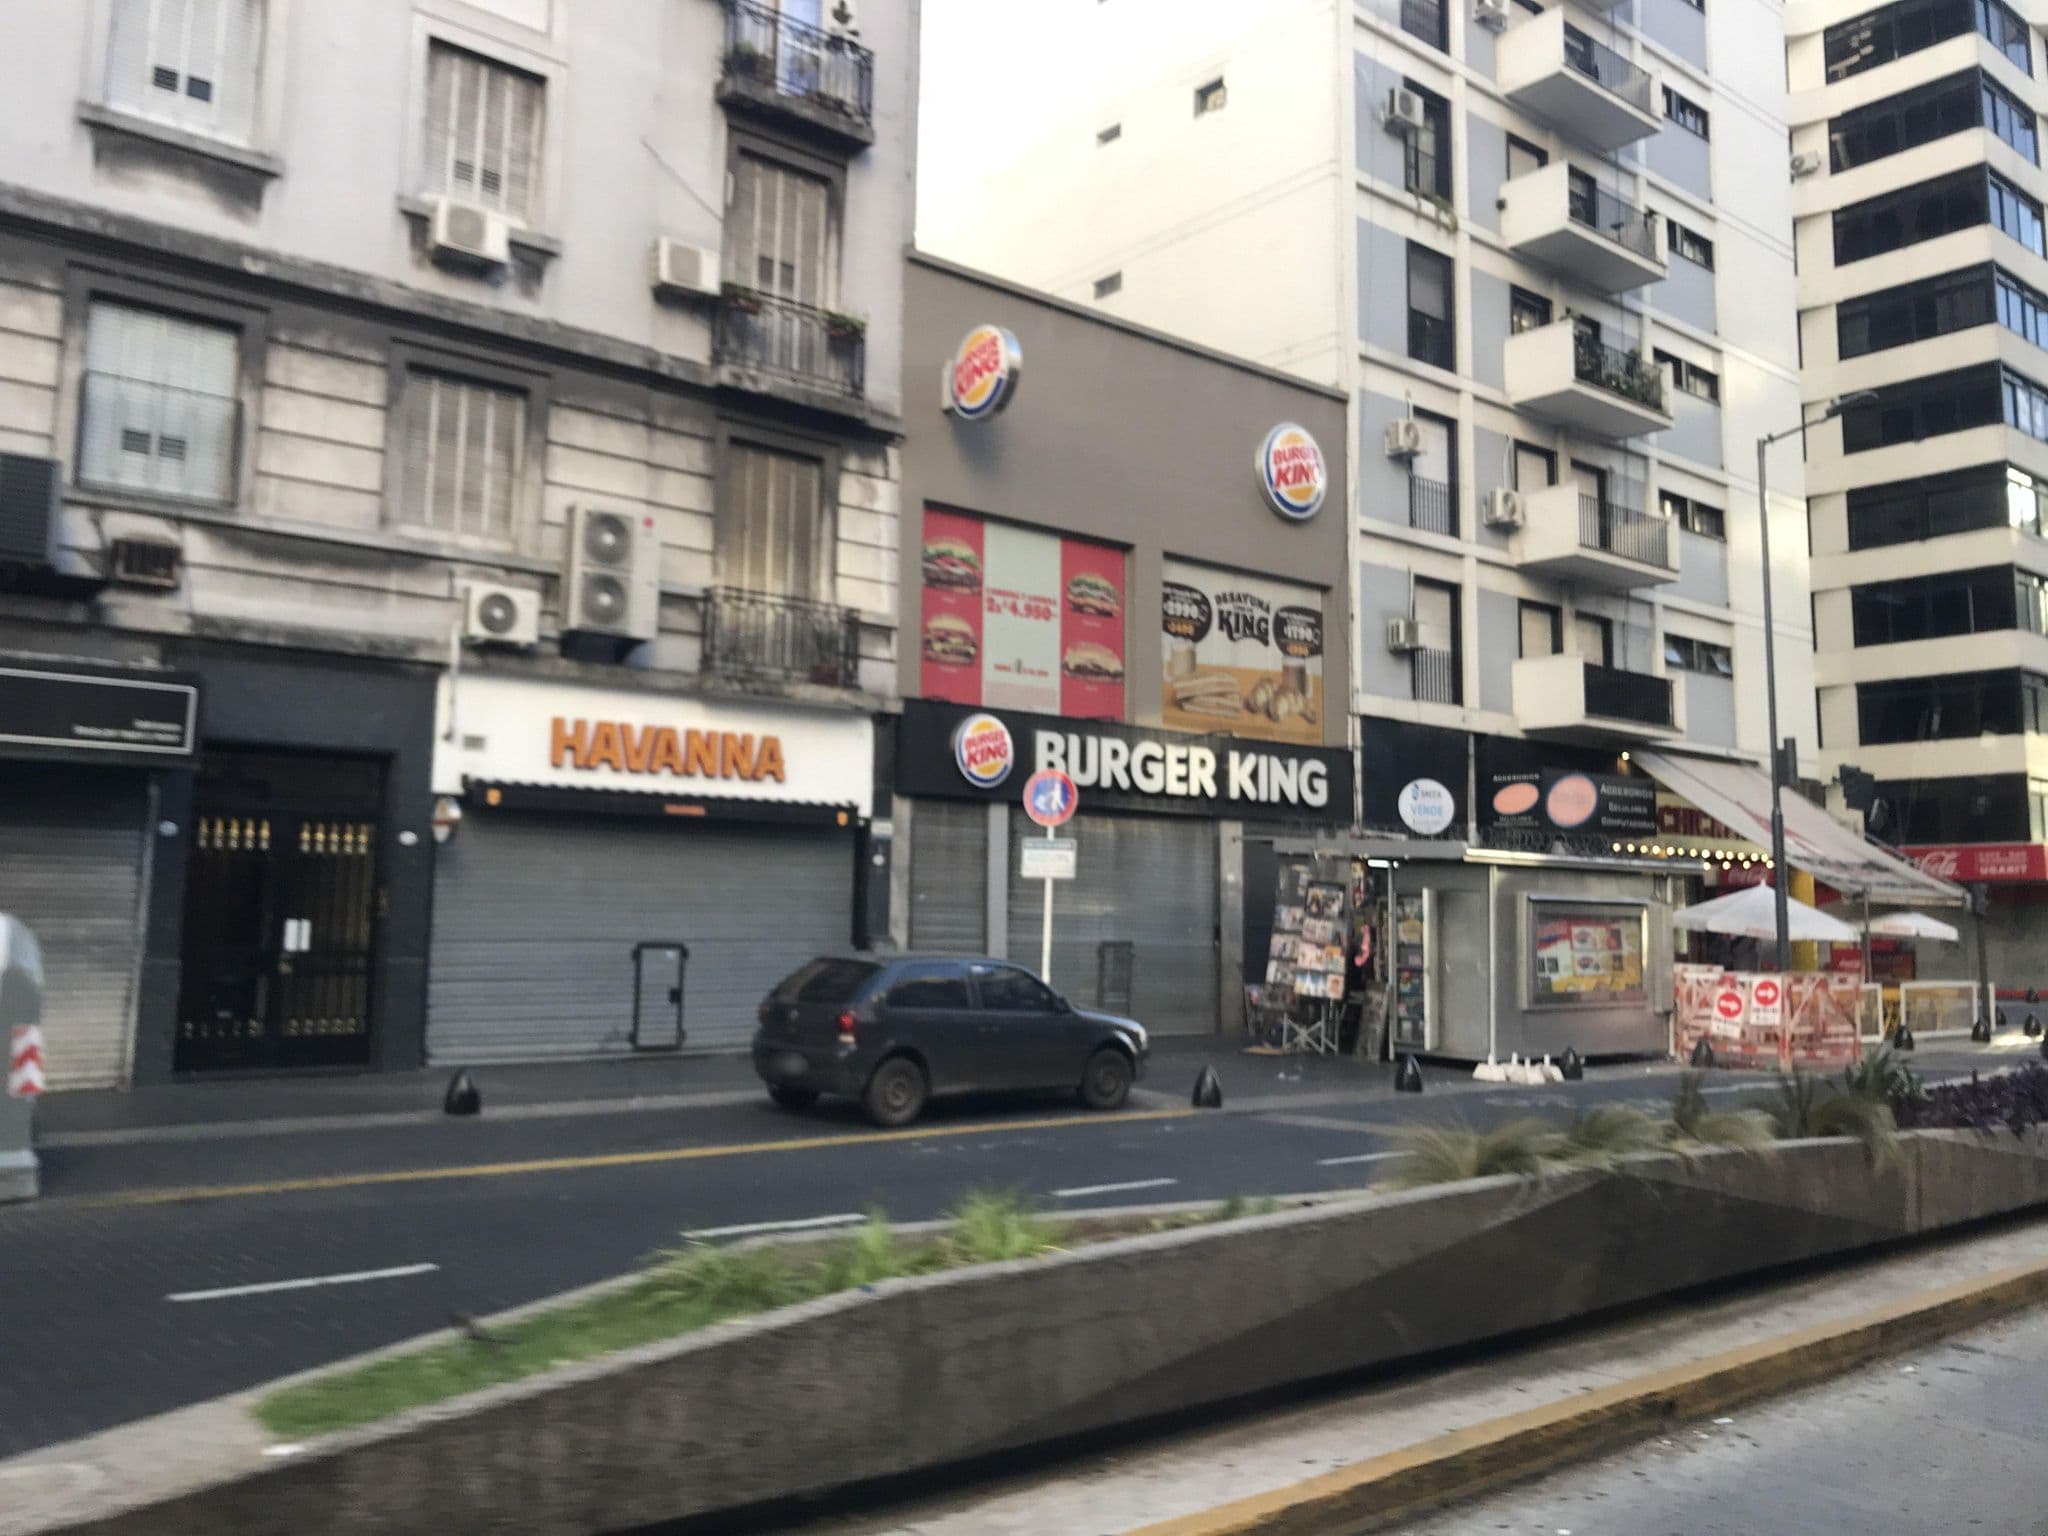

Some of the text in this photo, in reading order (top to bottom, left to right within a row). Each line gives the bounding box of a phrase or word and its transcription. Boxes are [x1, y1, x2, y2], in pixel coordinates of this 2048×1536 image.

[1218, 608, 1270, 648] KING
[552, 716, 786, 783] HAVANNA
[965, 743, 1009, 769] KING
[1035, 730, 1329, 808] BURGER KING
